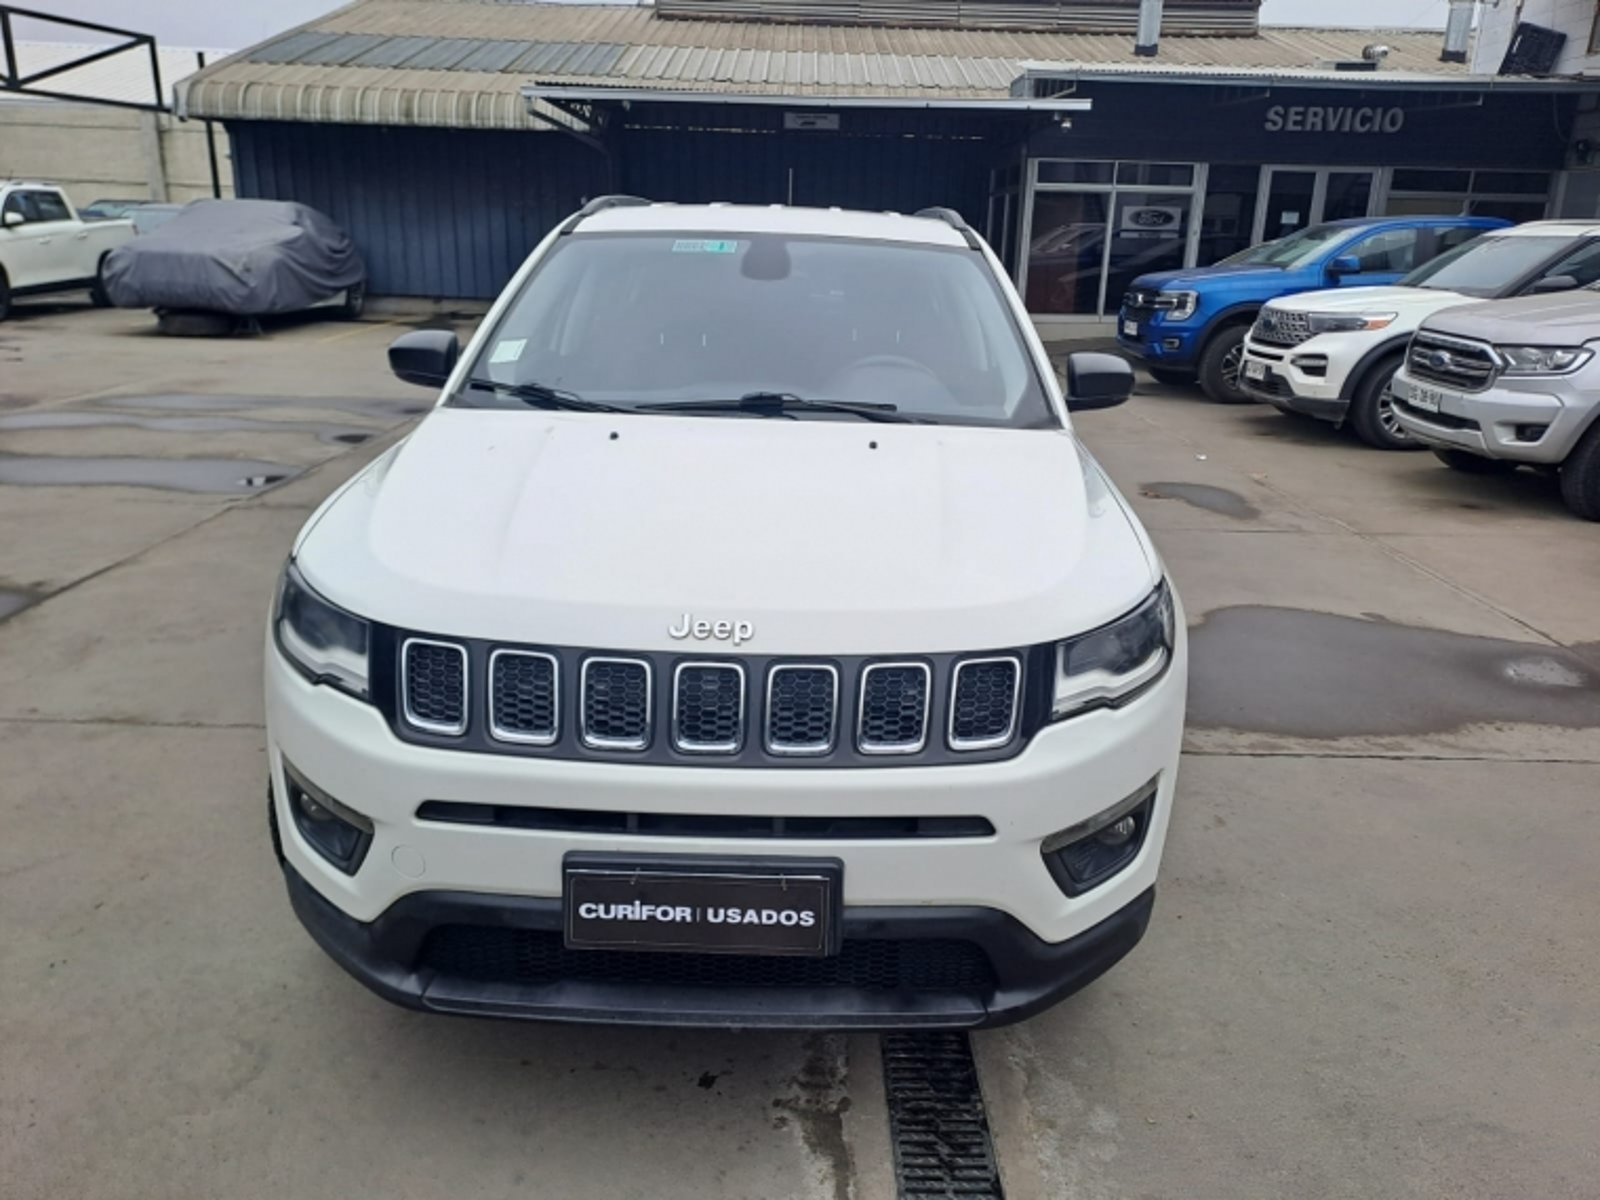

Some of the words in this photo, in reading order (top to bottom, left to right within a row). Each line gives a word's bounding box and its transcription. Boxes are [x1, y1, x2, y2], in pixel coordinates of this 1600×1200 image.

[1265, 105, 1405, 133] SERVICIO
[668, 613, 754, 645] Jeep
[706, 907, 816, 926] USADOS
